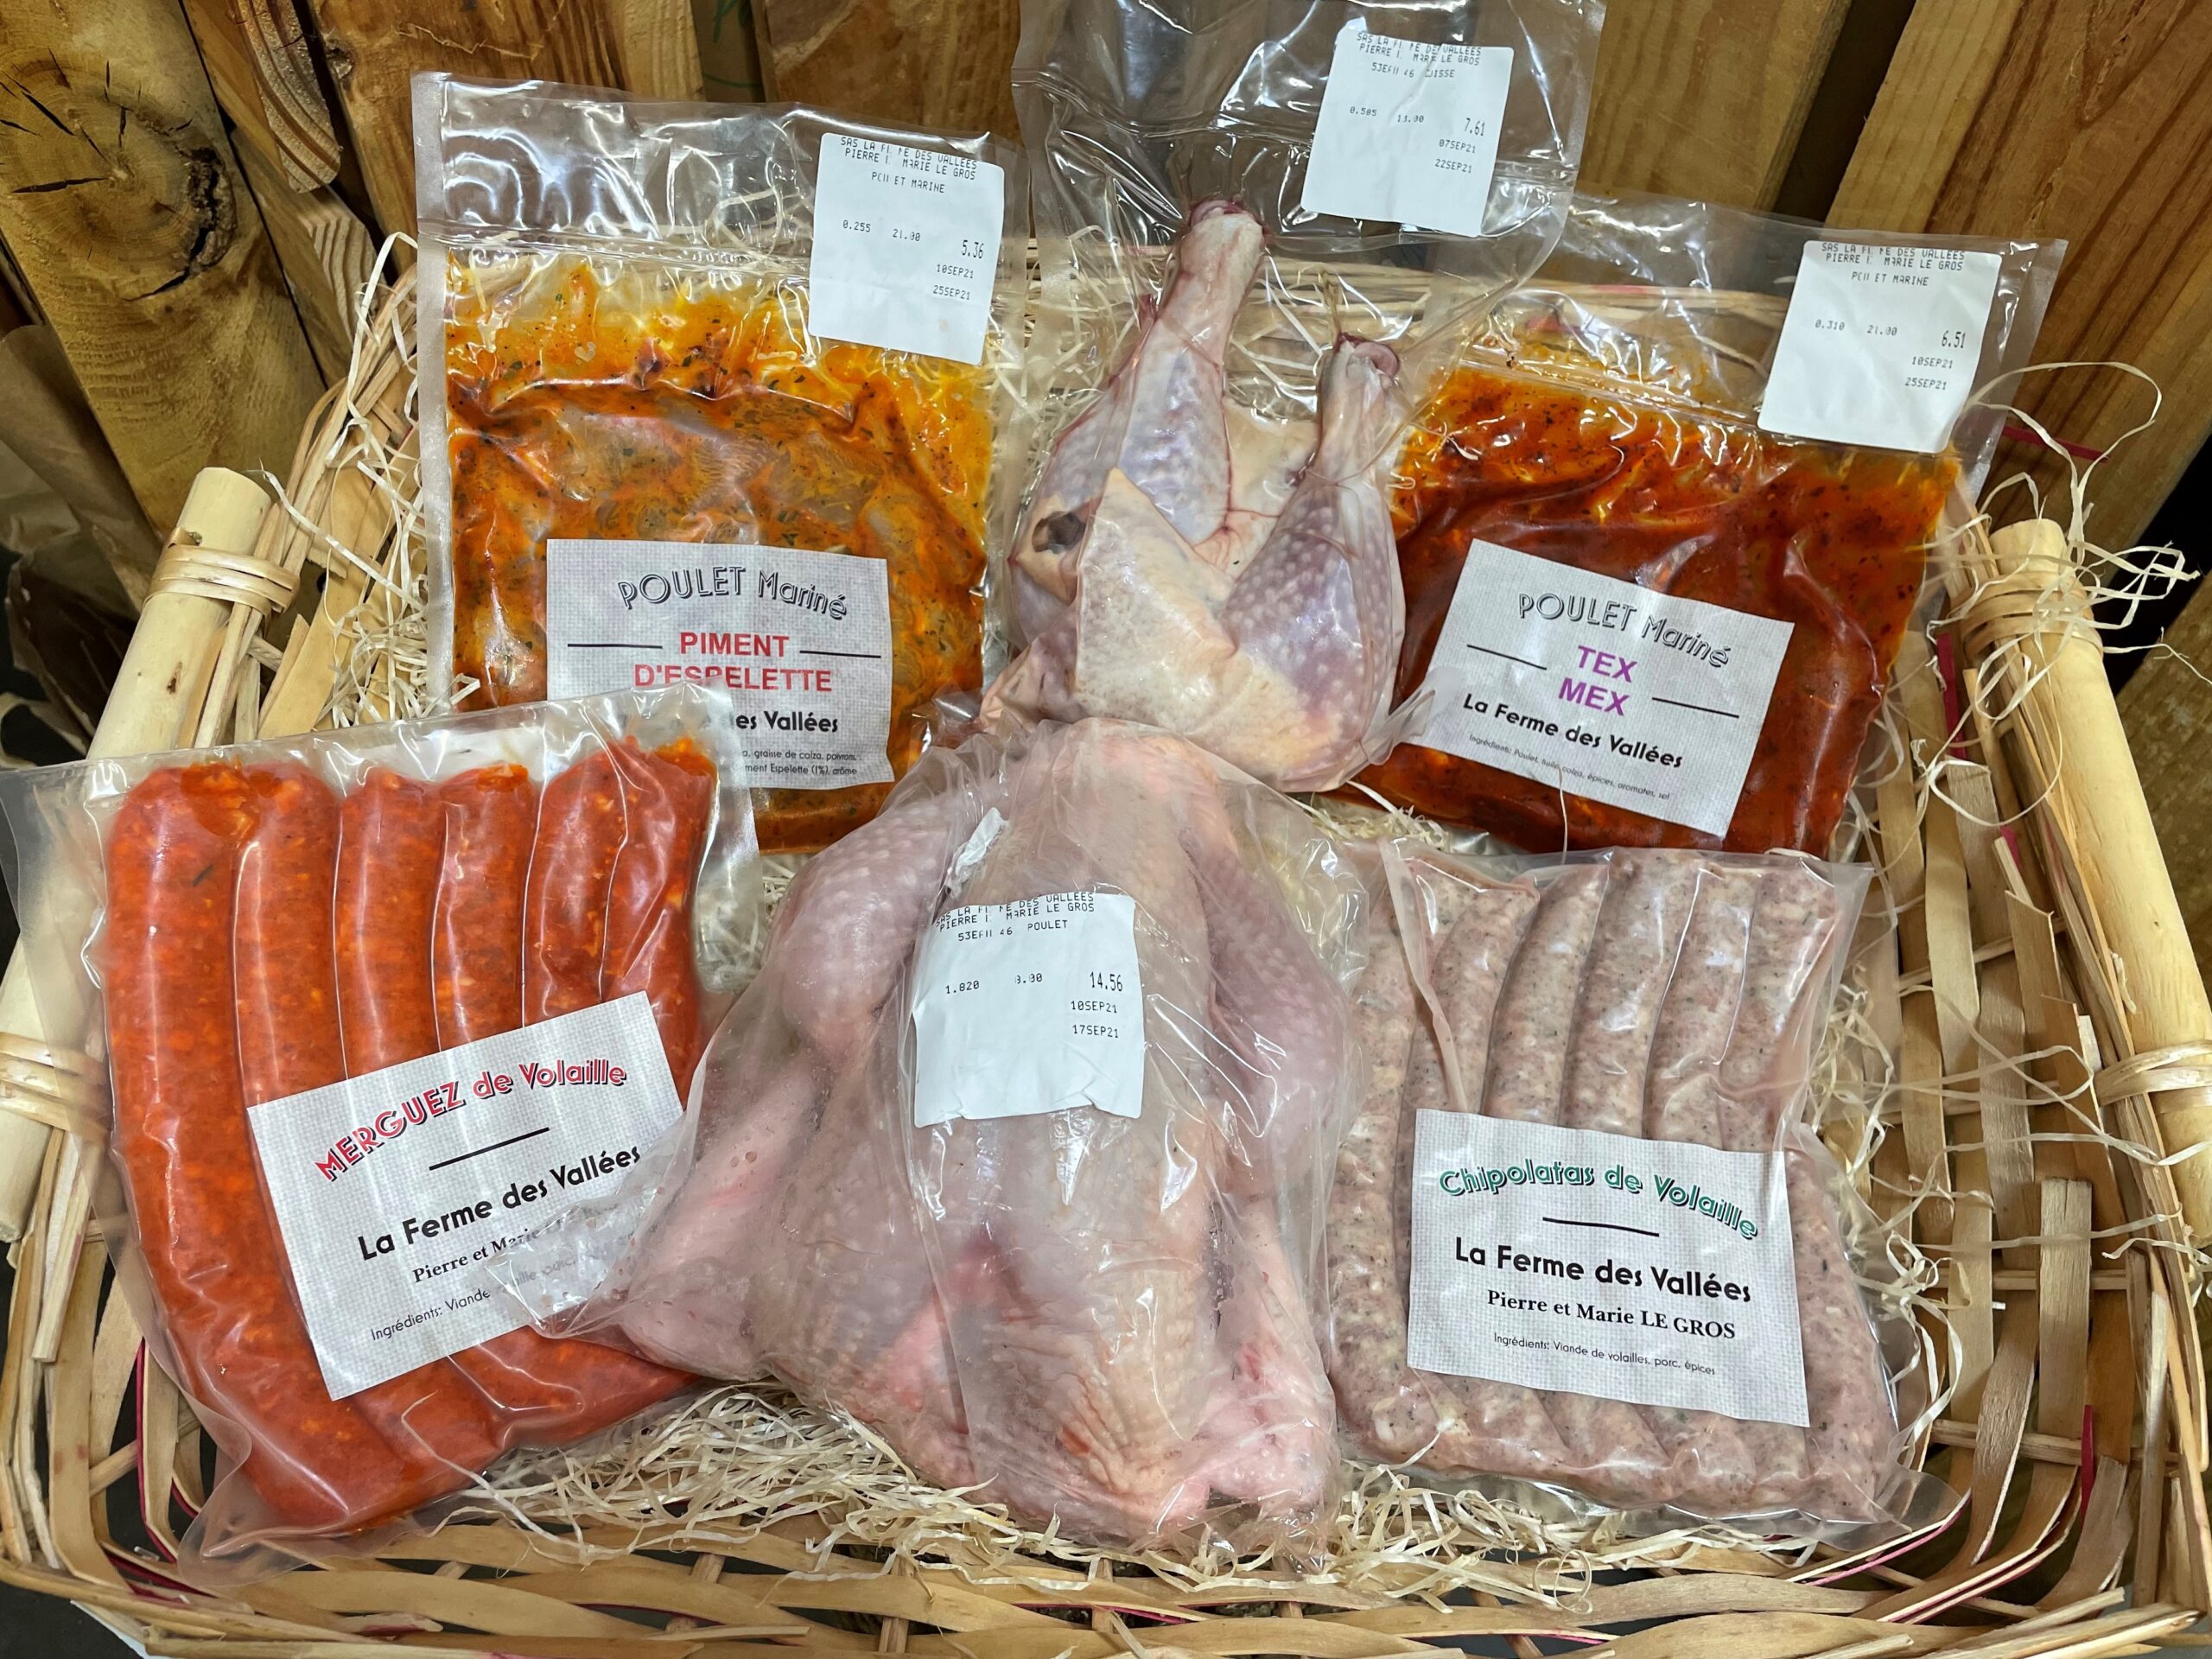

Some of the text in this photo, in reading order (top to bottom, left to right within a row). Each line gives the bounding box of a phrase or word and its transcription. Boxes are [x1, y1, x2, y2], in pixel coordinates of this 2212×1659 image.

[1359, 44, 1392, 57] PIERRE
[1442, 54, 1453, 64] LE
[1458, 54, 1480, 67] GROS
[1376, 36, 1389, 47] LA
[1442, 46, 1482, 57] VALLEES
[1465, 118, 1485, 137] 7.61
[841, 137, 858, 148] SAS
[863, 141, 877, 151] LA
[915, 150, 932, 162] DES
[938, 156, 977, 169] VALLEES
[1439, 139, 1476, 154] 07SEP21
[845, 148, 880, 162] PIERRE
[937, 165, 948, 175] LE
[953, 168, 976, 181] GROS
[1434, 158, 1472, 174] 22SEP21
[842, 219, 871, 233] 0.255
[961, 239, 984, 259] 5.36
[1821, 242, 1839, 252] SAS
[1844, 244, 1857, 253] LA
[1897, 247, 1916, 257] DES
[1922, 248, 1966, 260] VALLEES
[937, 264, 974, 279] 10SEP21
[1826, 253, 1860, 264] PIERRE
[1919, 259, 1932, 269] LE
[1938, 261, 1963, 271] GROS
[933, 285, 970, 301] 25SEP21
[1815, 320, 1845, 331] 0.310
[1942, 330, 1966, 349] 6.51
[1911, 356, 1954, 369] 10SEP21
[1904, 378, 1947, 391] 25SEP21
[618, 566, 848, 621] POULET Mariné
[1518, 593, 1732, 669] POULET Mariné
[680, 632, 790, 657] PIMENT
[1578, 645, 1638, 683] TEX
[1558, 677, 1630, 716] MEX
[734, 710, 838, 733] es Vallées
[1463, 693, 1683, 768] La Ferme des Vallées
[754, 749, 782, 760] graisse
[785, 749, 797, 759] de
[1469, 734, 1513, 754] Ingrédients:
[1658, 791, 1670, 801] sel
[771, 764, 809, 775] Espelette
[832, 765, 858, 775] arôme
[940, 915, 977, 932] PIERRE
[1046, 904, 1060, 913] LE
[1068, 902, 1095, 912] GROS
[957, 906, 971, 918] LA
[1020, 899, 1039, 909] DES
[1046, 892, 1094, 903] VALLEES
[1027, 920, 1068, 931] POULET
[945, 981, 980, 995] 1.820
[1090, 971, 1123, 992] 14.56
[1071, 1001, 1118, 1014] 10SEP21
[1072, 1025, 1119, 1039] 17SEP21
[315, 1058, 627, 1183] MERGUEZ de Volaille
[358, 1147, 641, 1261] La Ferme des Vallées
[1440, 1159, 1758, 1240] Chipolatas de Volaille
[412, 1255, 469, 1284] Pierre
[473, 1245, 489, 1262] et
[1456, 1236, 1751, 1302] La Ferme des Vallées
[371, 1306, 443, 1341] Ingrédients:
[445, 1287, 491, 1312] Viande
[1488, 1290, 1736, 1339] Pierre et Marie LE GROS
[1494, 1332, 1550, 1351] Ingrédients:
[1553, 1340, 1588, 1356] Viande
[1591, 1347, 1605, 1359] de
[1684, 1360, 1715, 1376] épices
